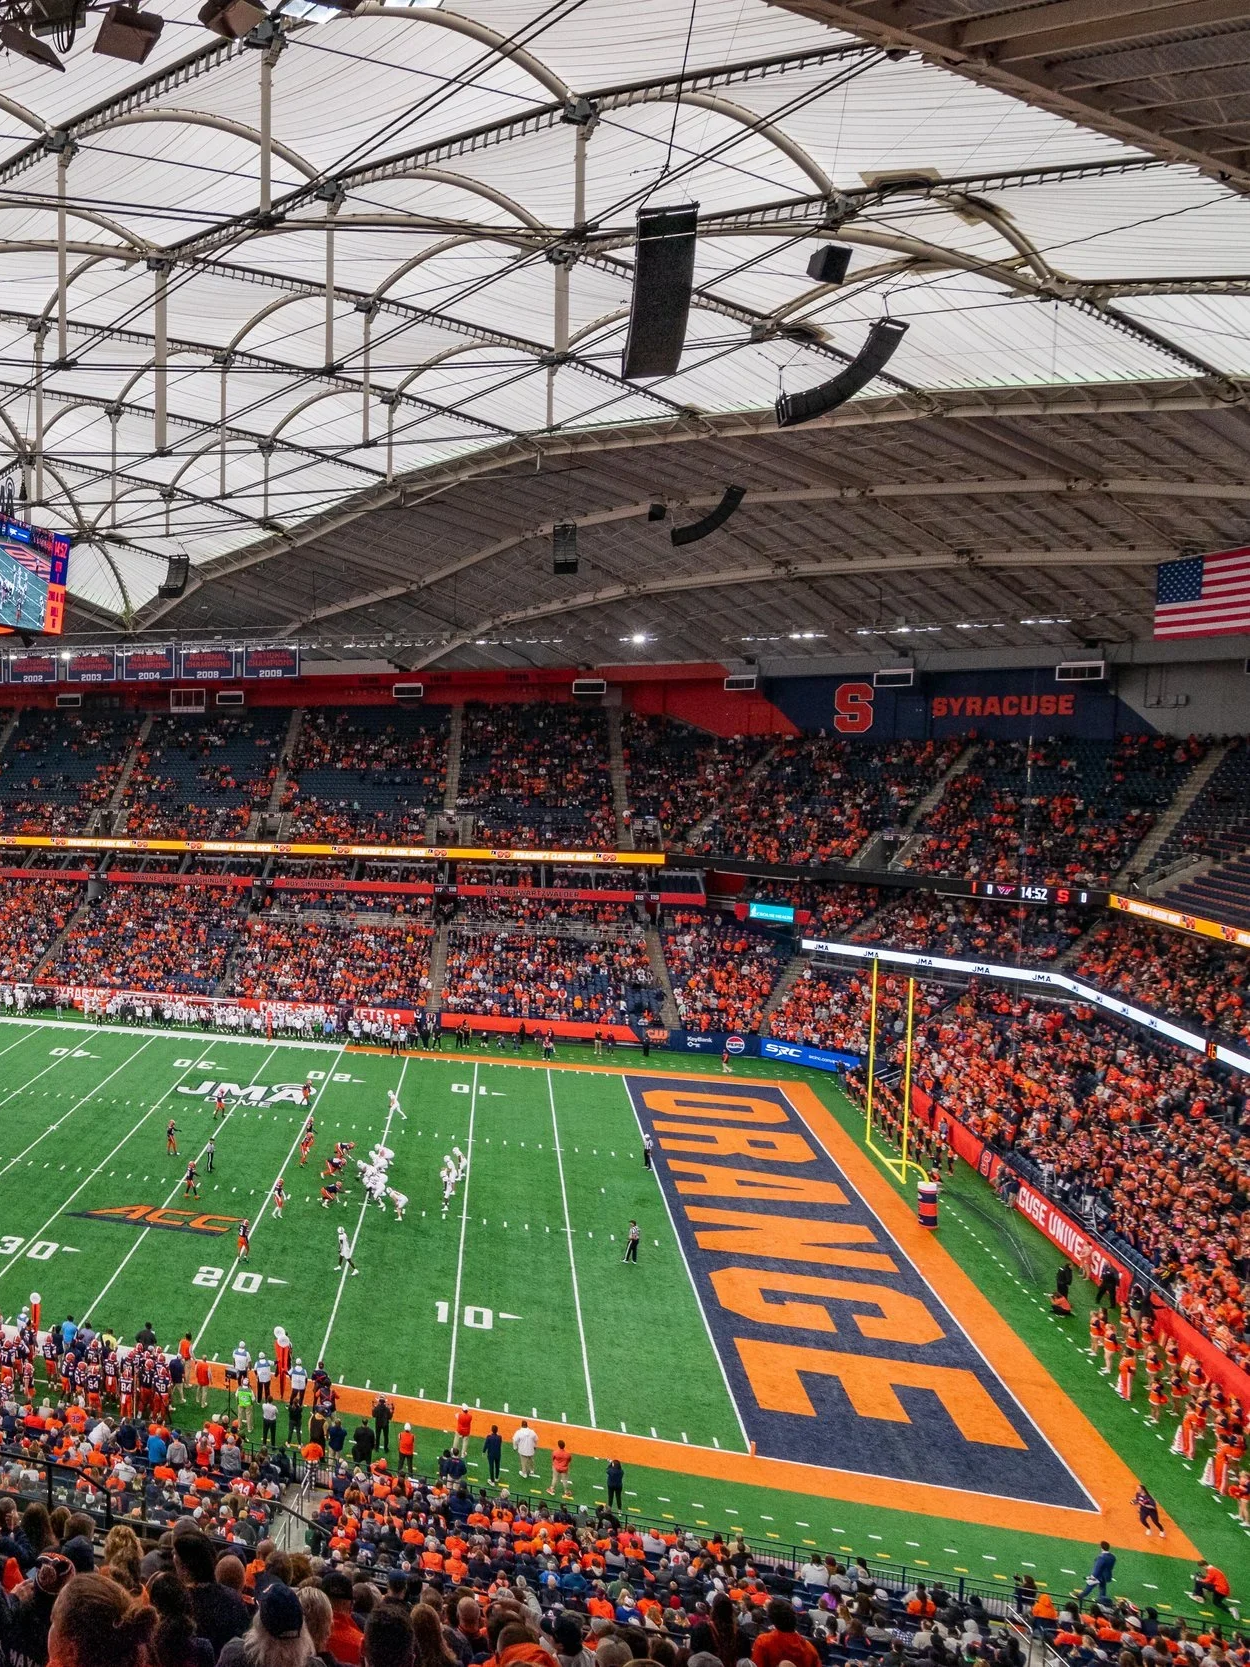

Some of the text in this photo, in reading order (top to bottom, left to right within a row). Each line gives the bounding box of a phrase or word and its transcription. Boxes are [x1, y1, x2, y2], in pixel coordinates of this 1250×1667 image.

[130, 654, 168, 662] NATIONAL
[126, 661, 171, 669] CHAMPIONS
[185, 660, 232, 668] CHAMPIONS
[81, 673, 102, 682] 2003
[138, 671, 160, 680] 2004
[196, 670, 219, 679] 2008
[259, 669, 282, 677] 2009
[23, 674, 44, 683] 2002
[834, 682, 875, 733] S
[931, 694, 1076, 716] SYRACUSE
[503, 889, 580, 898] SCHWARTZWALDER
[1021, 886, 1048, 900] 14:52
[1056, 889, 1069, 902] S
[813, 943, 829, 952] JMA
[862, 950, 879, 958] JMA
[915, 957, 933, 966] JMA
[971, 965, 990, 974] JMA
[1031, 973, 1052, 983] JMA
[687, 1036, 713, 1044] KeyBank
[765, 1043, 803, 1058] SRC
[173, 1059, 216, 1070] 30
[307, 1070, 352, 1082] 20
[176, 1080, 310, 1105] JMA
[451, 1083, 487, 1095] 10
[204, 1096, 273, 1108] DOME
[84, 1204, 248, 1234] ACC
[641, 1089, 1030, 1450] ORANGE
[191, 1266, 264, 1294] 20
[435, 1301, 494, 1331] 10
[121, 1382, 132, 1393] 84
[237, 1482, 251, 1496] 44
